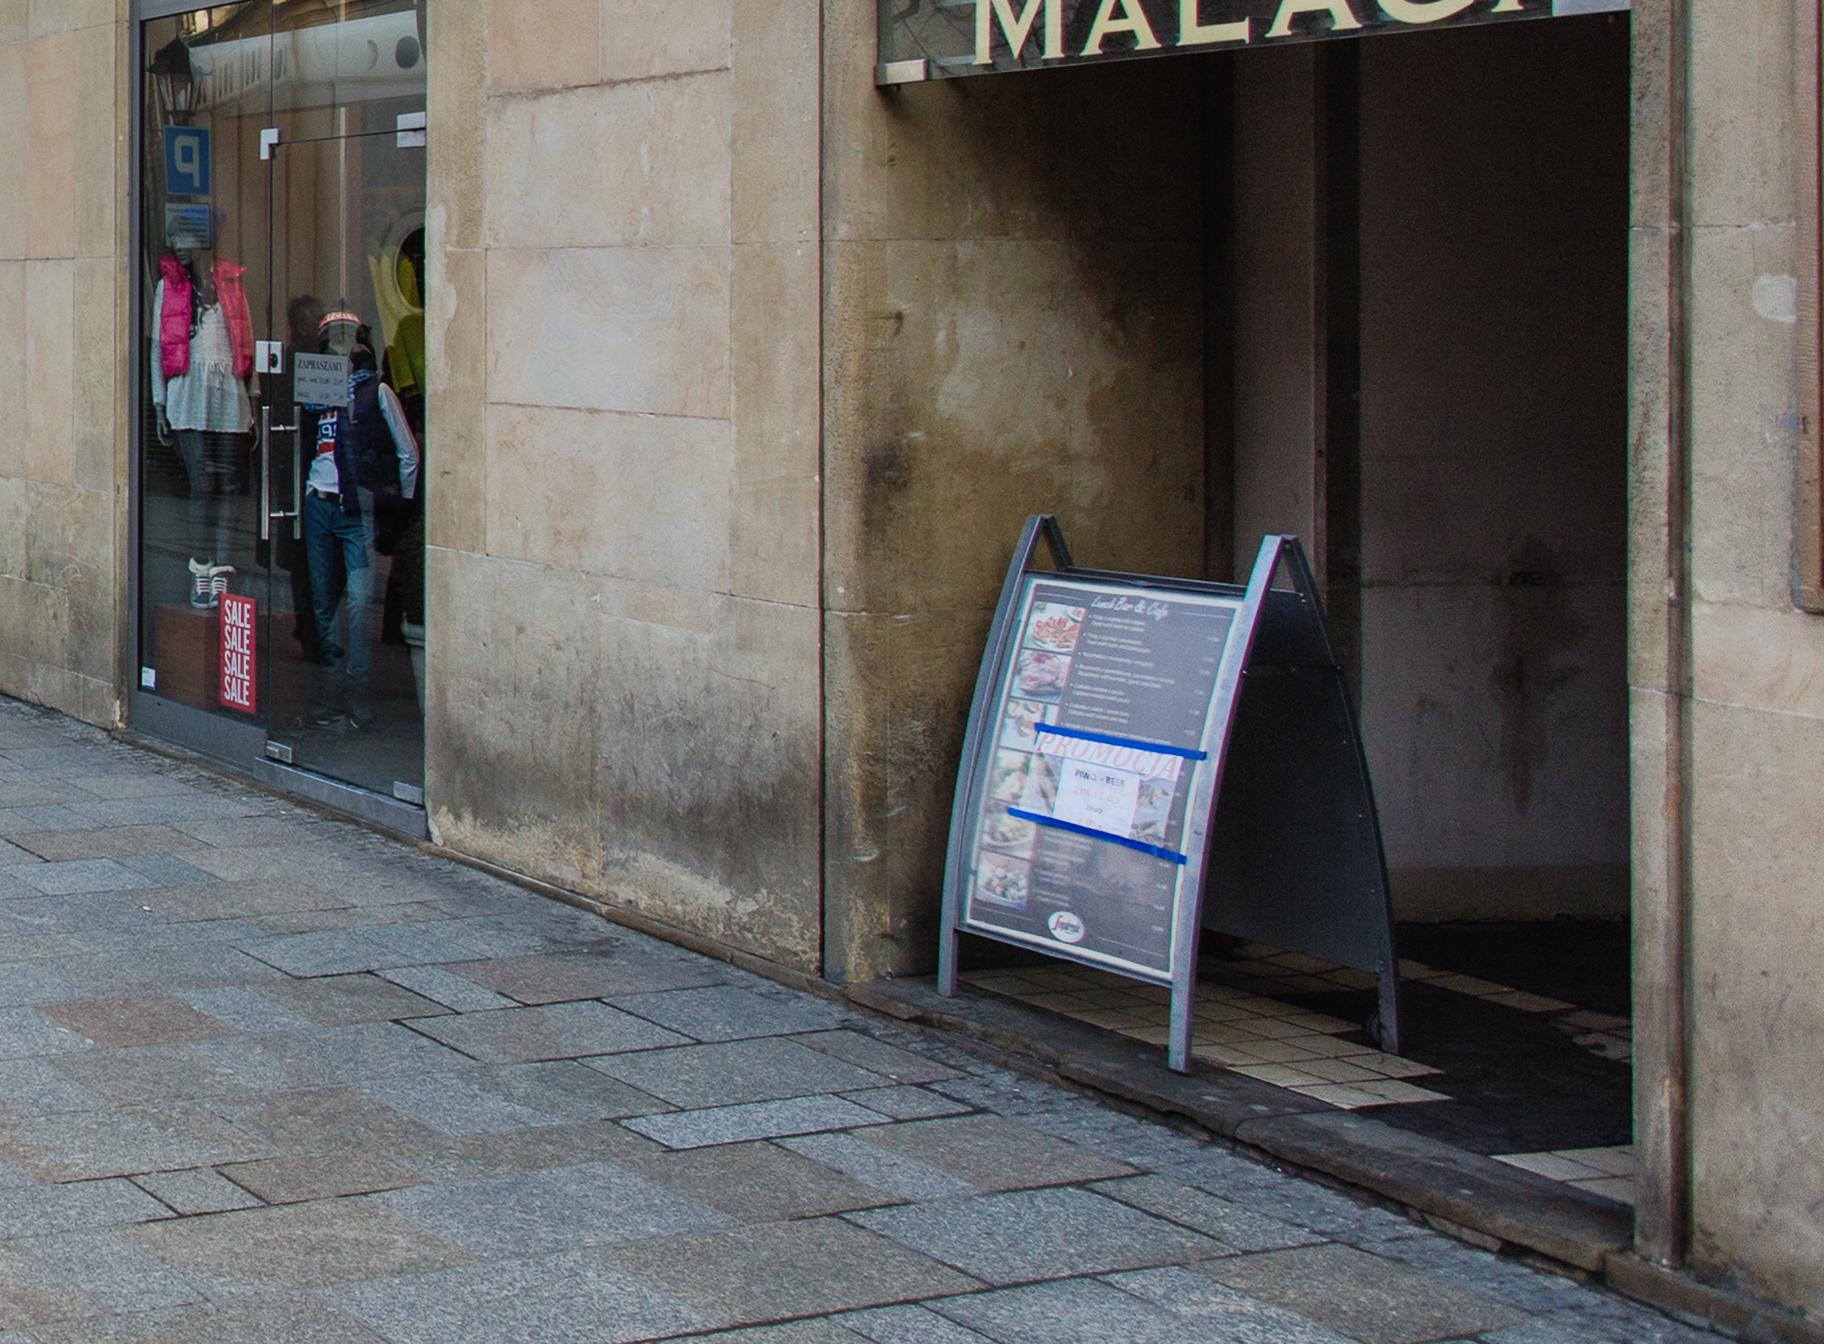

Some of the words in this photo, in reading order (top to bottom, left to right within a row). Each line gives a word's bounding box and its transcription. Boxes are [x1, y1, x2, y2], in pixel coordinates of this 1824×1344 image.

[297, 359, 343, 372] ZAPRASZAMY
[224, 599, 250, 628] SALE
[224, 625, 250, 654] SALE
[224, 651, 250, 680] SALE
[224, 677, 250, 706] SALE
[1038, 733, 1179, 780] PROMOCJA
